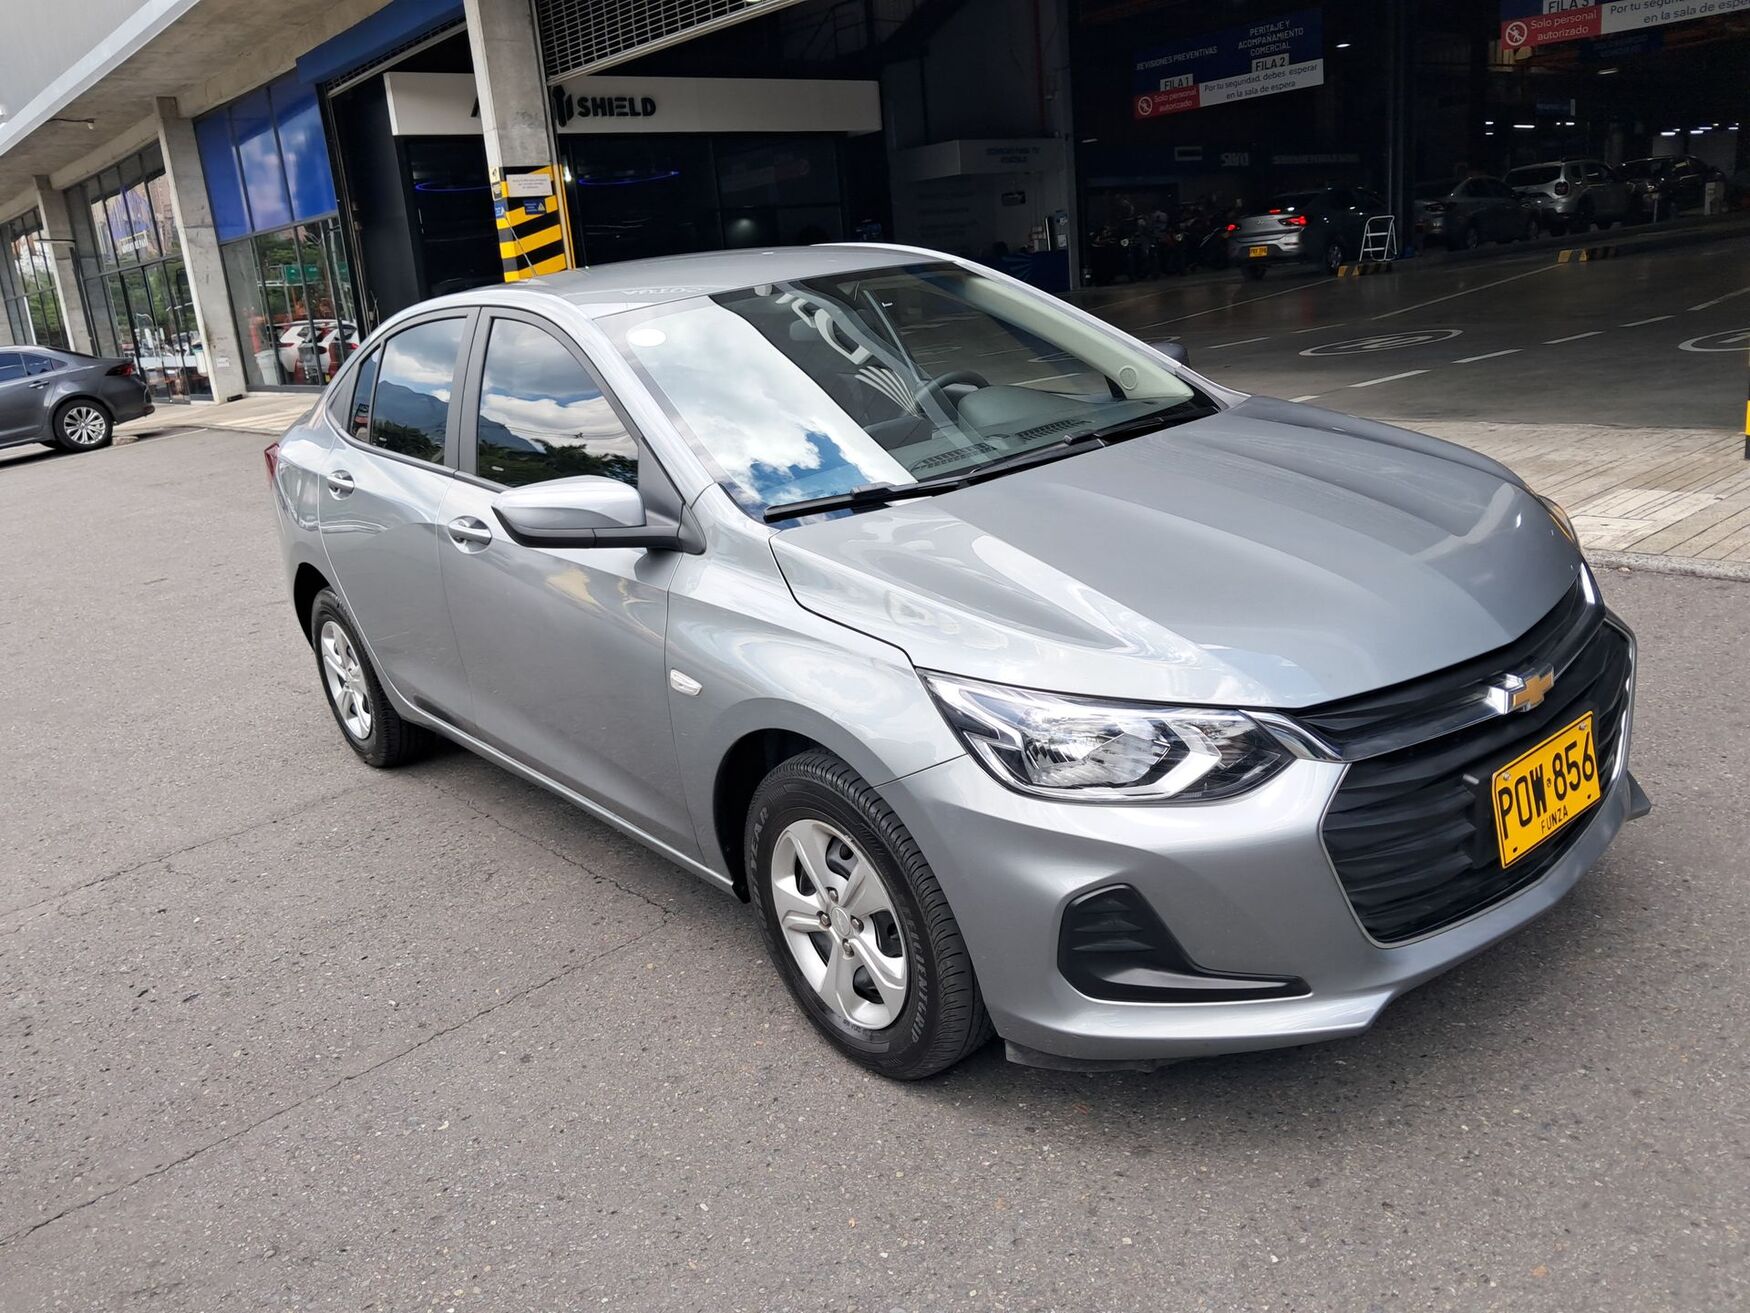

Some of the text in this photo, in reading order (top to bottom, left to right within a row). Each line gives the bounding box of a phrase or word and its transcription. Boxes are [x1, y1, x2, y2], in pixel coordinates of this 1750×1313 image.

[1610, 5, 1627, 15] Por
[1629, 2, 1641, 12] tu
[1643, 0, 1750, 24] en la sala de espe
[1249, 19, 1291, 37] PERITAJE Y
[1530, 11, 1598, 30] Solo personal
[1537, 25, 1590, 41] autorizado
[1173, 45, 1218, 63] PREVENTIVAS
[1250, 40, 1292, 57] COMERCIAL
[1254, 57, 1287, 72] FILA 2
[1163, 76, 1190, 91] FILA 1
[1204, 83, 1216, 92] Por
[1288, 64, 1318, 77] esperar
[1168, 88, 1198, 102] personal
[1226, 92, 1235, 101] en
[1244, 86, 1259, 97] sala
[1260, 84, 1270, 94] de
[1270, 80, 1296, 93] espera
[576, 96, 657, 118] SHIELD
[1497, 730, 1595, 841] POW 856
[1540, 804, 1569, 835] FUNZA
